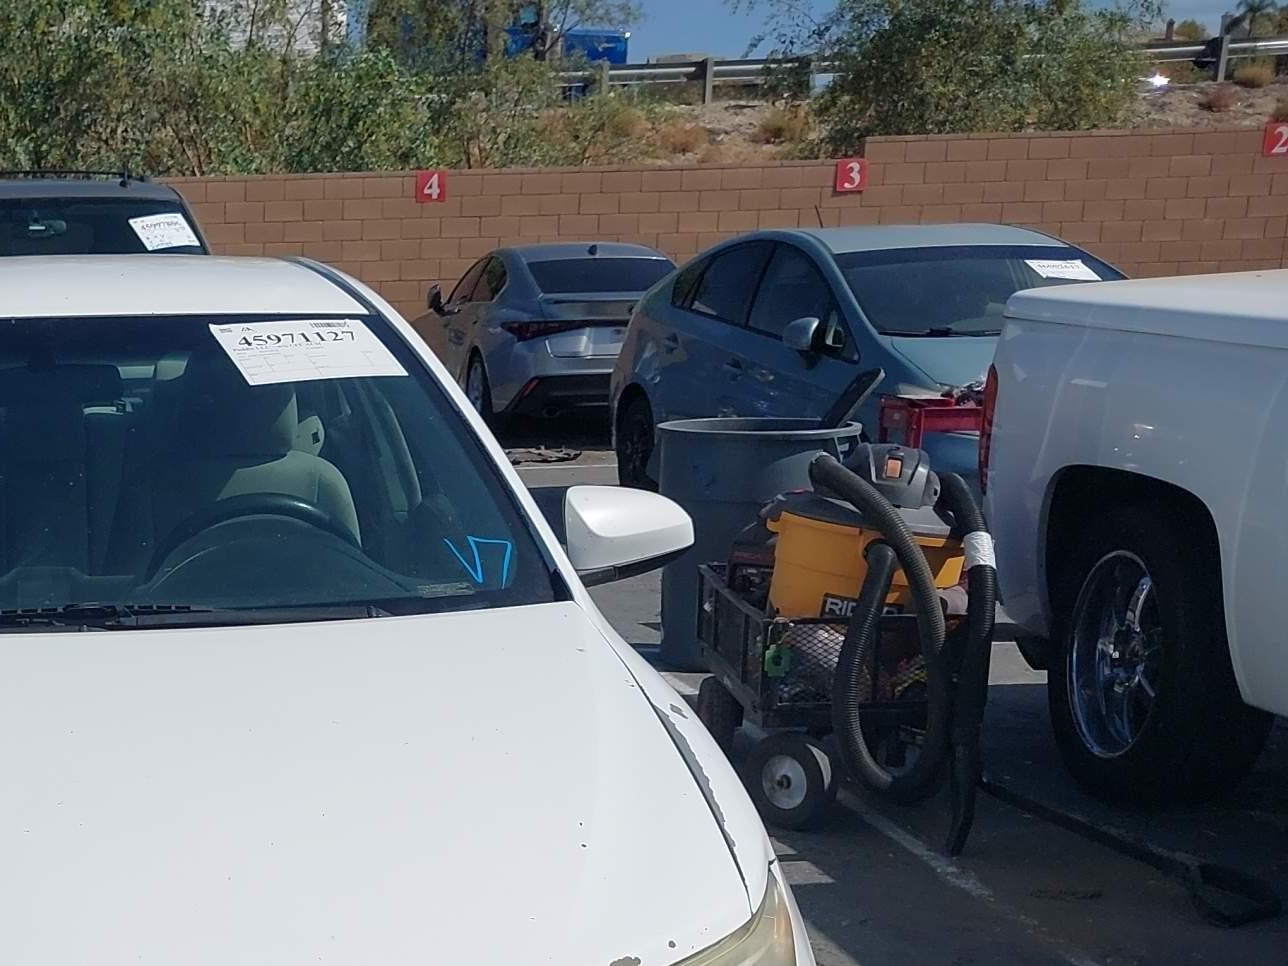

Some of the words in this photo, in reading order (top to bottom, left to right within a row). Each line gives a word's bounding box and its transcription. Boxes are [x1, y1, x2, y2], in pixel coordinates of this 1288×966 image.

[1271, 126, 1288, 153] 2
[423, 173, 441, 200] 4
[843, 161, 861, 189] 3
[238, 330, 356, 347] 45971127
